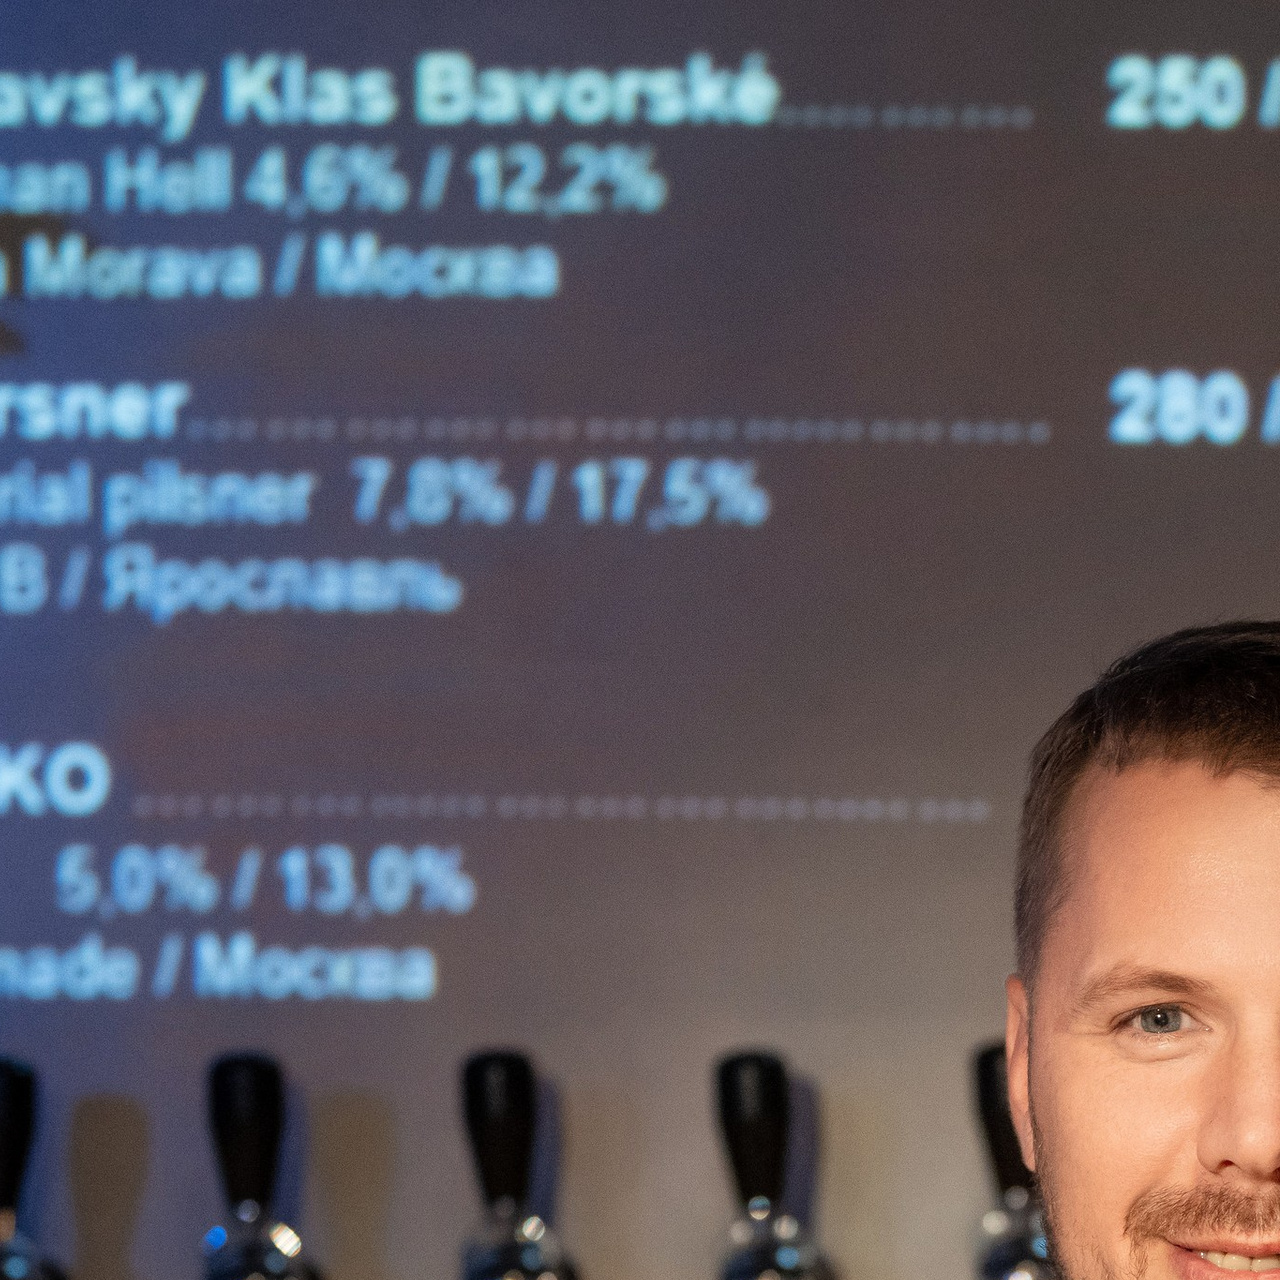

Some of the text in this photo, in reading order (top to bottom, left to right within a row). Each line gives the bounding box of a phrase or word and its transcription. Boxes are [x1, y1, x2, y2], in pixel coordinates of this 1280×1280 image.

[222, 53, 398, 126] Klas
[1105, 52, 1248, 131] 250
[0, 158, 92, 215] an
[244, 144, 409, 219] 4,6%
[422, 149, 451, 209] /
[469, 143, 667, 219] 12,2%
[22, 232, 263, 300] Morava
[274, 236, 304, 296] /
[315, 231, 560, 300] Москва
[1107, 367, 1251, 446] 280
[103, 459, 314, 538] pilsner
[354, 456, 514, 532] 7,8%
[526, 462, 556, 520] /
[572, 457, 770, 532] 17,5%
[0, 543, 463, 623] B / Ярославль
[55, 844, 475, 919] 5,0% / 13,0%
[153, 936, 183, 998] /
[192, 931, 438, 1001] Москва
